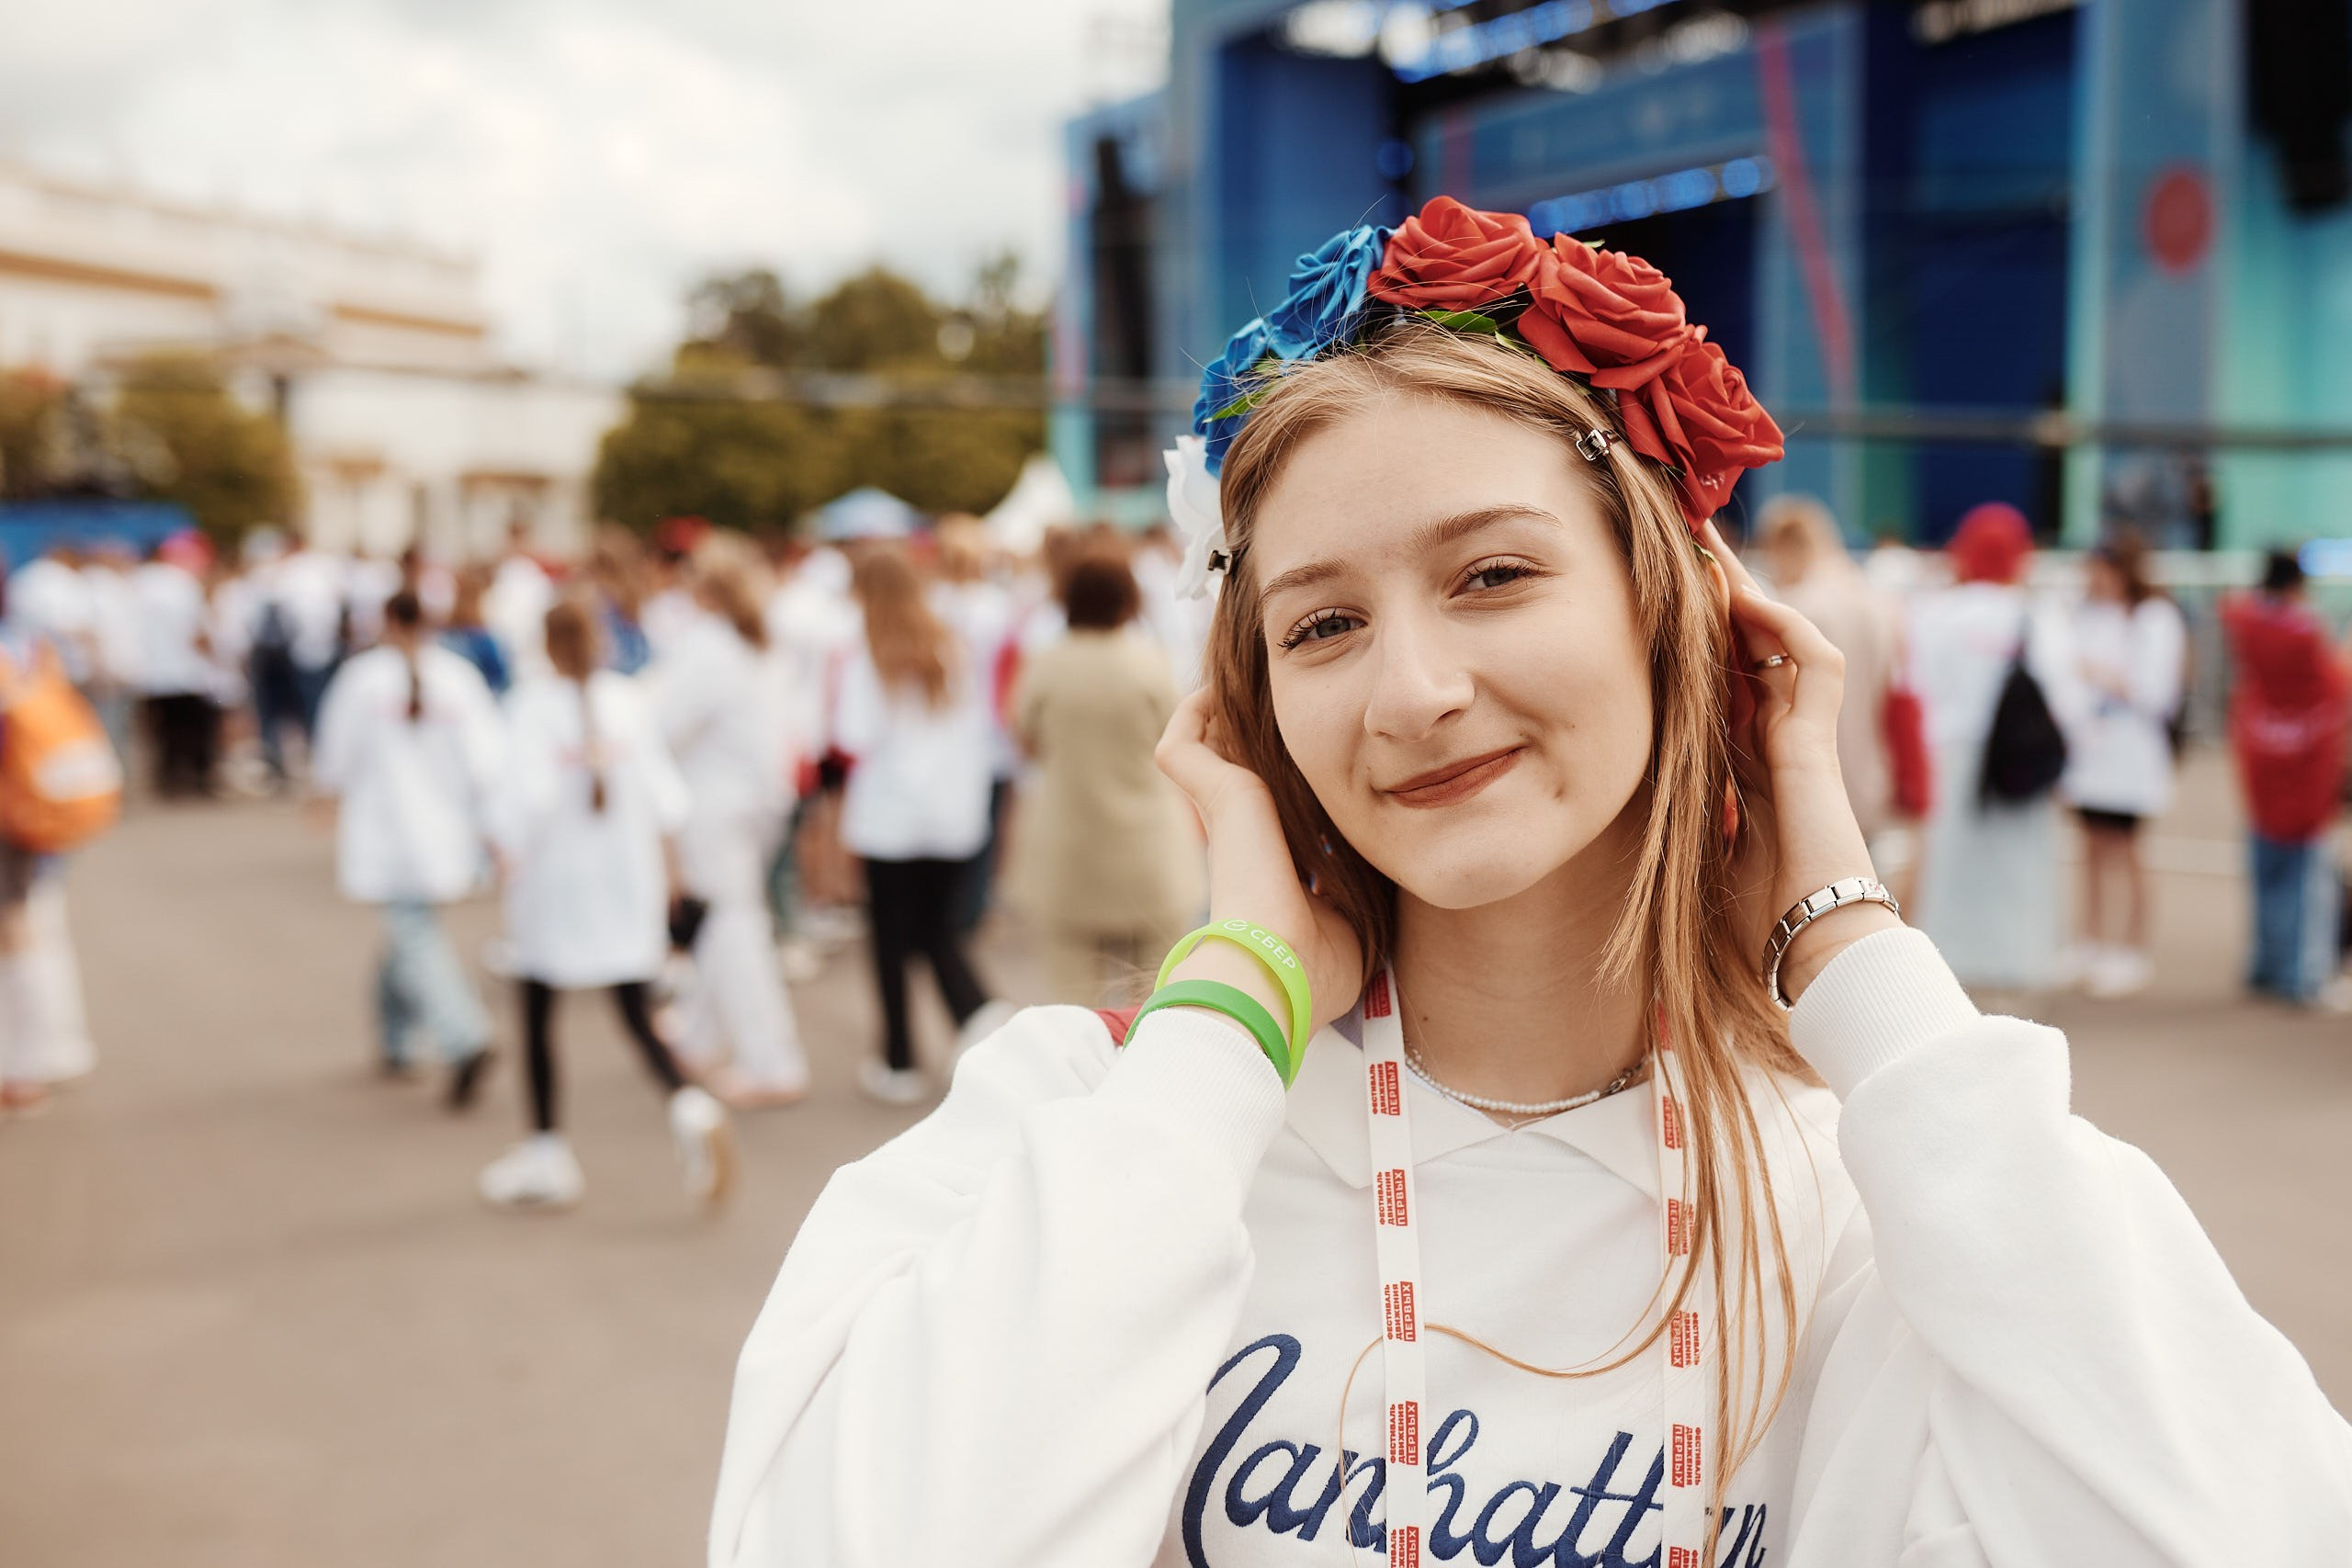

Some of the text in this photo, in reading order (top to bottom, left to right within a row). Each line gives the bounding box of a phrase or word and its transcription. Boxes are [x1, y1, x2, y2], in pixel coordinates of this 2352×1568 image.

[1250, 929, 1296, 969] СБЕР
[1369, 1064, 1378, 1114] ФЕСТИВАЛЬ
[1377, 1064, 1388, 1114] ДВИЖЕНИЯ
[1386, 1062, 1399, 1114] ПЕРВЫХ
[1377, 1171, 1385, 1225] ФЕСТИВАЛЬ
[1385, 1171, 1396, 1225] ДВИЖЕНИЯ
[1394, 1170, 1407, 1225] ПЕРВЫХ
[1385, 1284, 1394, 1340] ФЕСТИВАЛЬ
[1392, 1284, 1403, 1340] ДВИЖЕНИЯ
[1402, 1283, 1415, 1341] ПЕРВЫХ
[1397, 1404, 1406, 1463] ДВИЖЕНИЯ
[1407, 1403, 1418, 1464] ПЕРВЫХ
[1673, 1425, 1684, 1485] ПЕРВЫХ
[1408, 1528, 1418, 1568] РВЫХ
